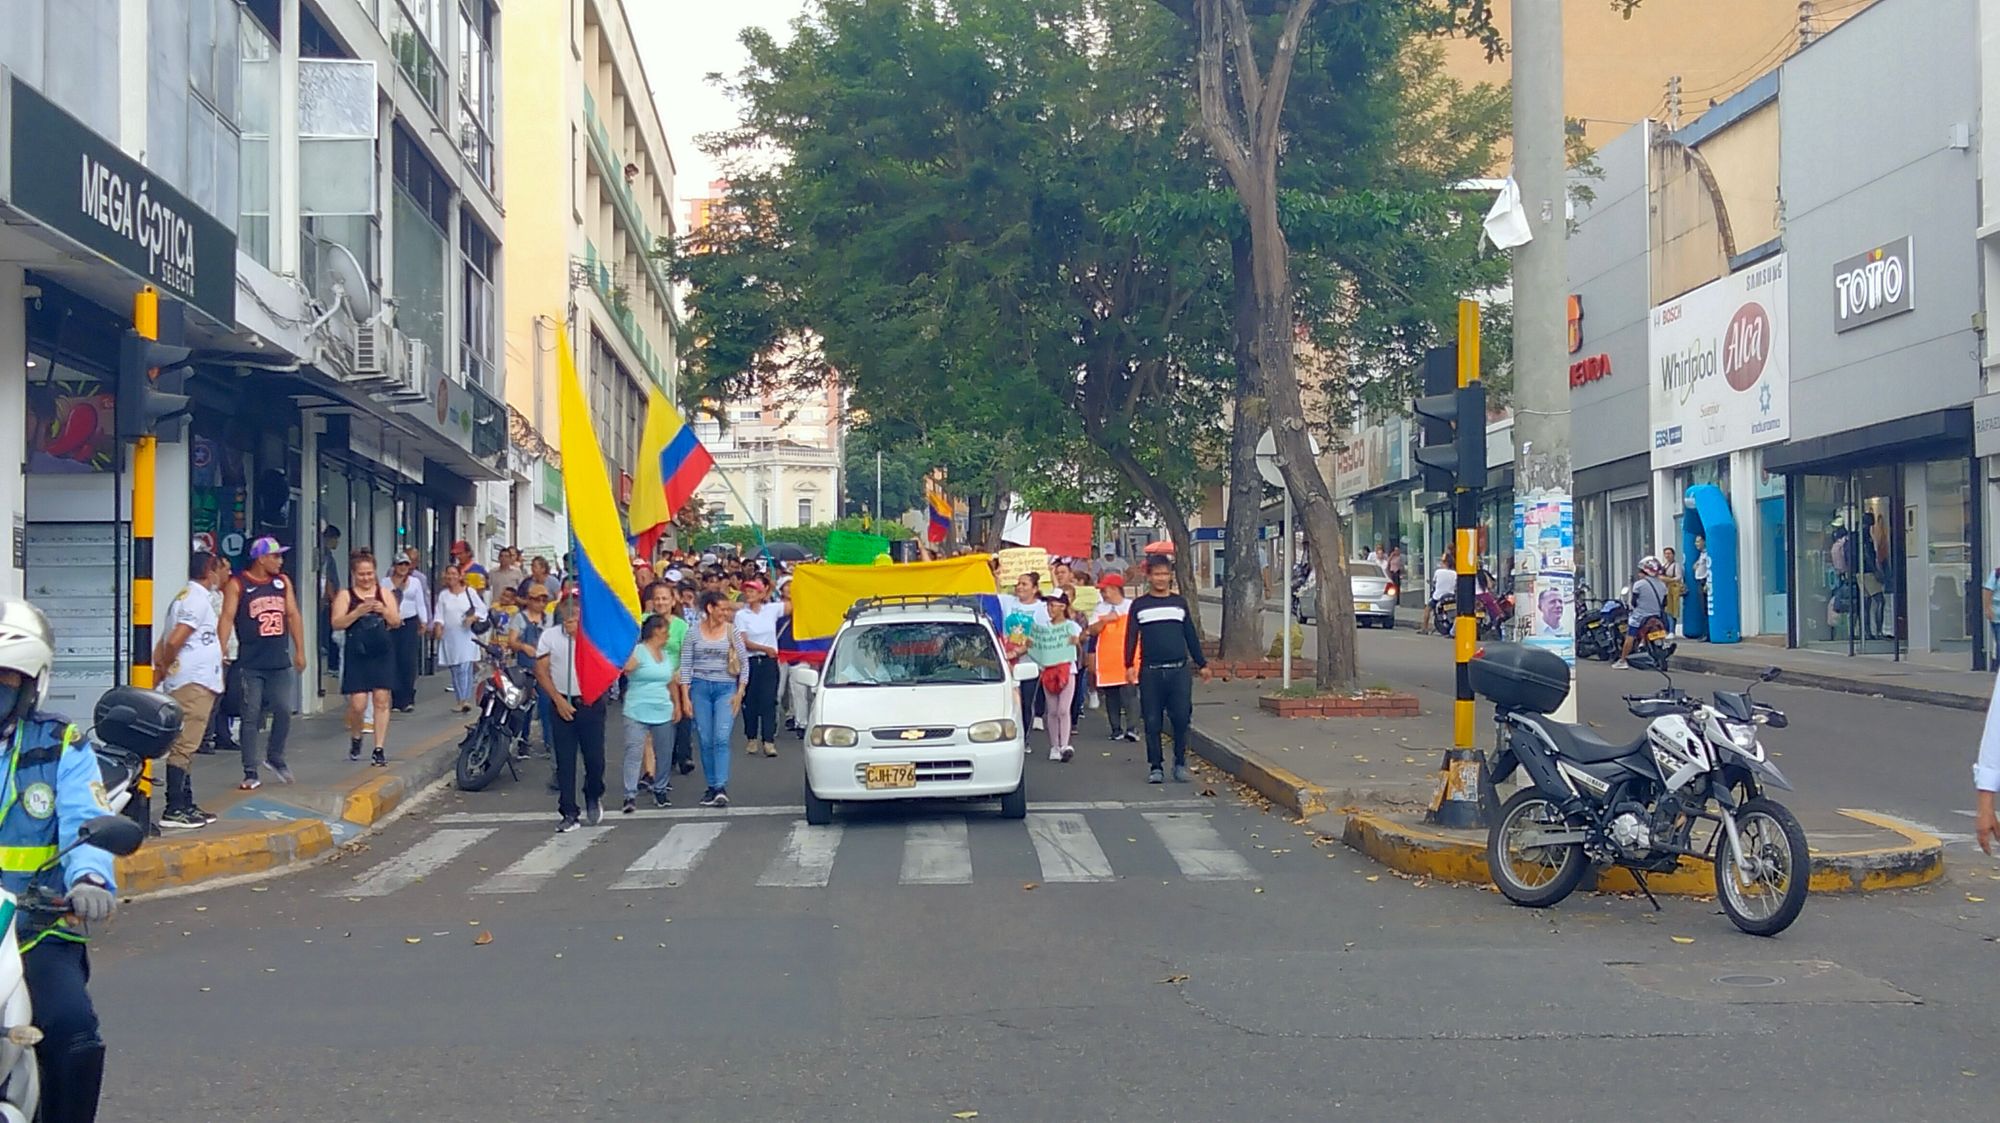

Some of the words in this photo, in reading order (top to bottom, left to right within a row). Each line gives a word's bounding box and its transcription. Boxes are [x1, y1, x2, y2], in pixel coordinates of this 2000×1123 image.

[82, 153, 133, 240] MEGA
[137, 179, 195, 276] ÓPTICA
[162, 261, 194, 297] SELECTA
[1746, 261, 1783, 291] SAMSUNG
[1836, 255, 1903, 319] TOTTO
[1662, 304, 1682, 326] BOSCH
[1726, 316, 1762, 374] Alca
[1661, 338, 1717, 396] Whirlpool
[258, 612, 284, 636] 23
[867, 767, 914, 783] CJH-796
